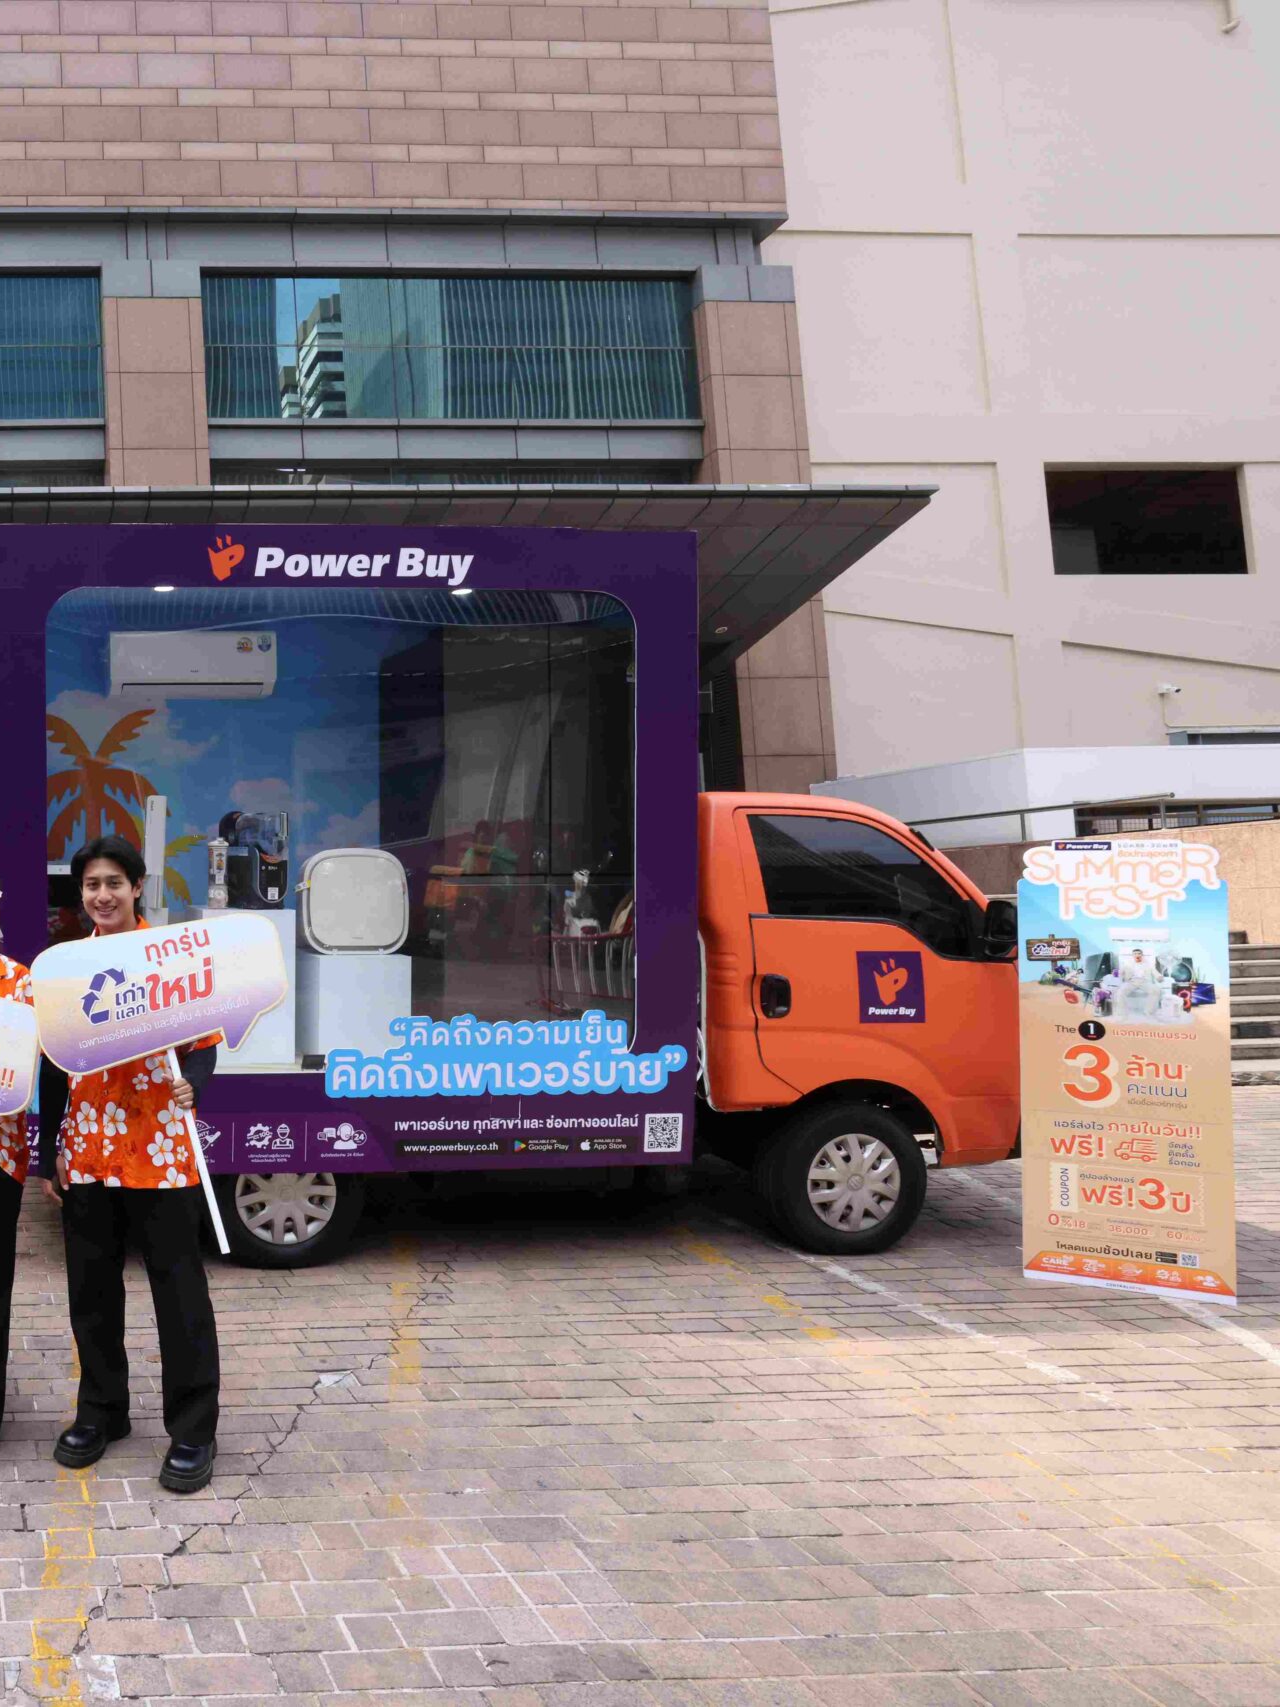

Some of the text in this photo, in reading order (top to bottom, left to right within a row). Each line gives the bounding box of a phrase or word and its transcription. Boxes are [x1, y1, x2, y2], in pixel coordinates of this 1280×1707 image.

[254, 546, 474, 586] Power Buy
[1063, 884, 1181, 918] FEST
[144, 926, 211, 966] ทุกรุ่น
[115, 957, 214, 1012] เก่า ใหม่
[115, 1004, 146, 1021] แลก
[194, 1008, 201, 1017] 4
[868, 1007, 916, 1017] Power Buy
[392, 1016, 623, 1047] “คิดถึงความเย็น
[1055, 1024, 1198, 1041] The แจกคะแนนรวม
[331, 1049, 682, 1091] คิดถึงเพาเวอร์บาย”
[1063, 1044, 1113, 1101] 3
[1127, 1083, 1187, 1098] คะแนน
[394, 1113, 639, 1134] เพาเวอร์บาย ทุกสาขา และ ช่องทางออนไลน์
[1054, 1119, 1202, 1139] แอร์ส่งไว ภายในวัน!!
[353, 1133, 365, 1142] 24
[404, 1142, 499, 1153] www.powerbuy.co.th
[554, 1144, 569, 1152] Play
[594, 1143, 607, 1151] App
[1050, 1134, 1103, 1158] ฟรี!
[1060, 1167, 1069, 1207] COUPON
[1080, 1182, 1133, 1207] ฟรี!
[1138, 1178, 1166, 1210] 3
